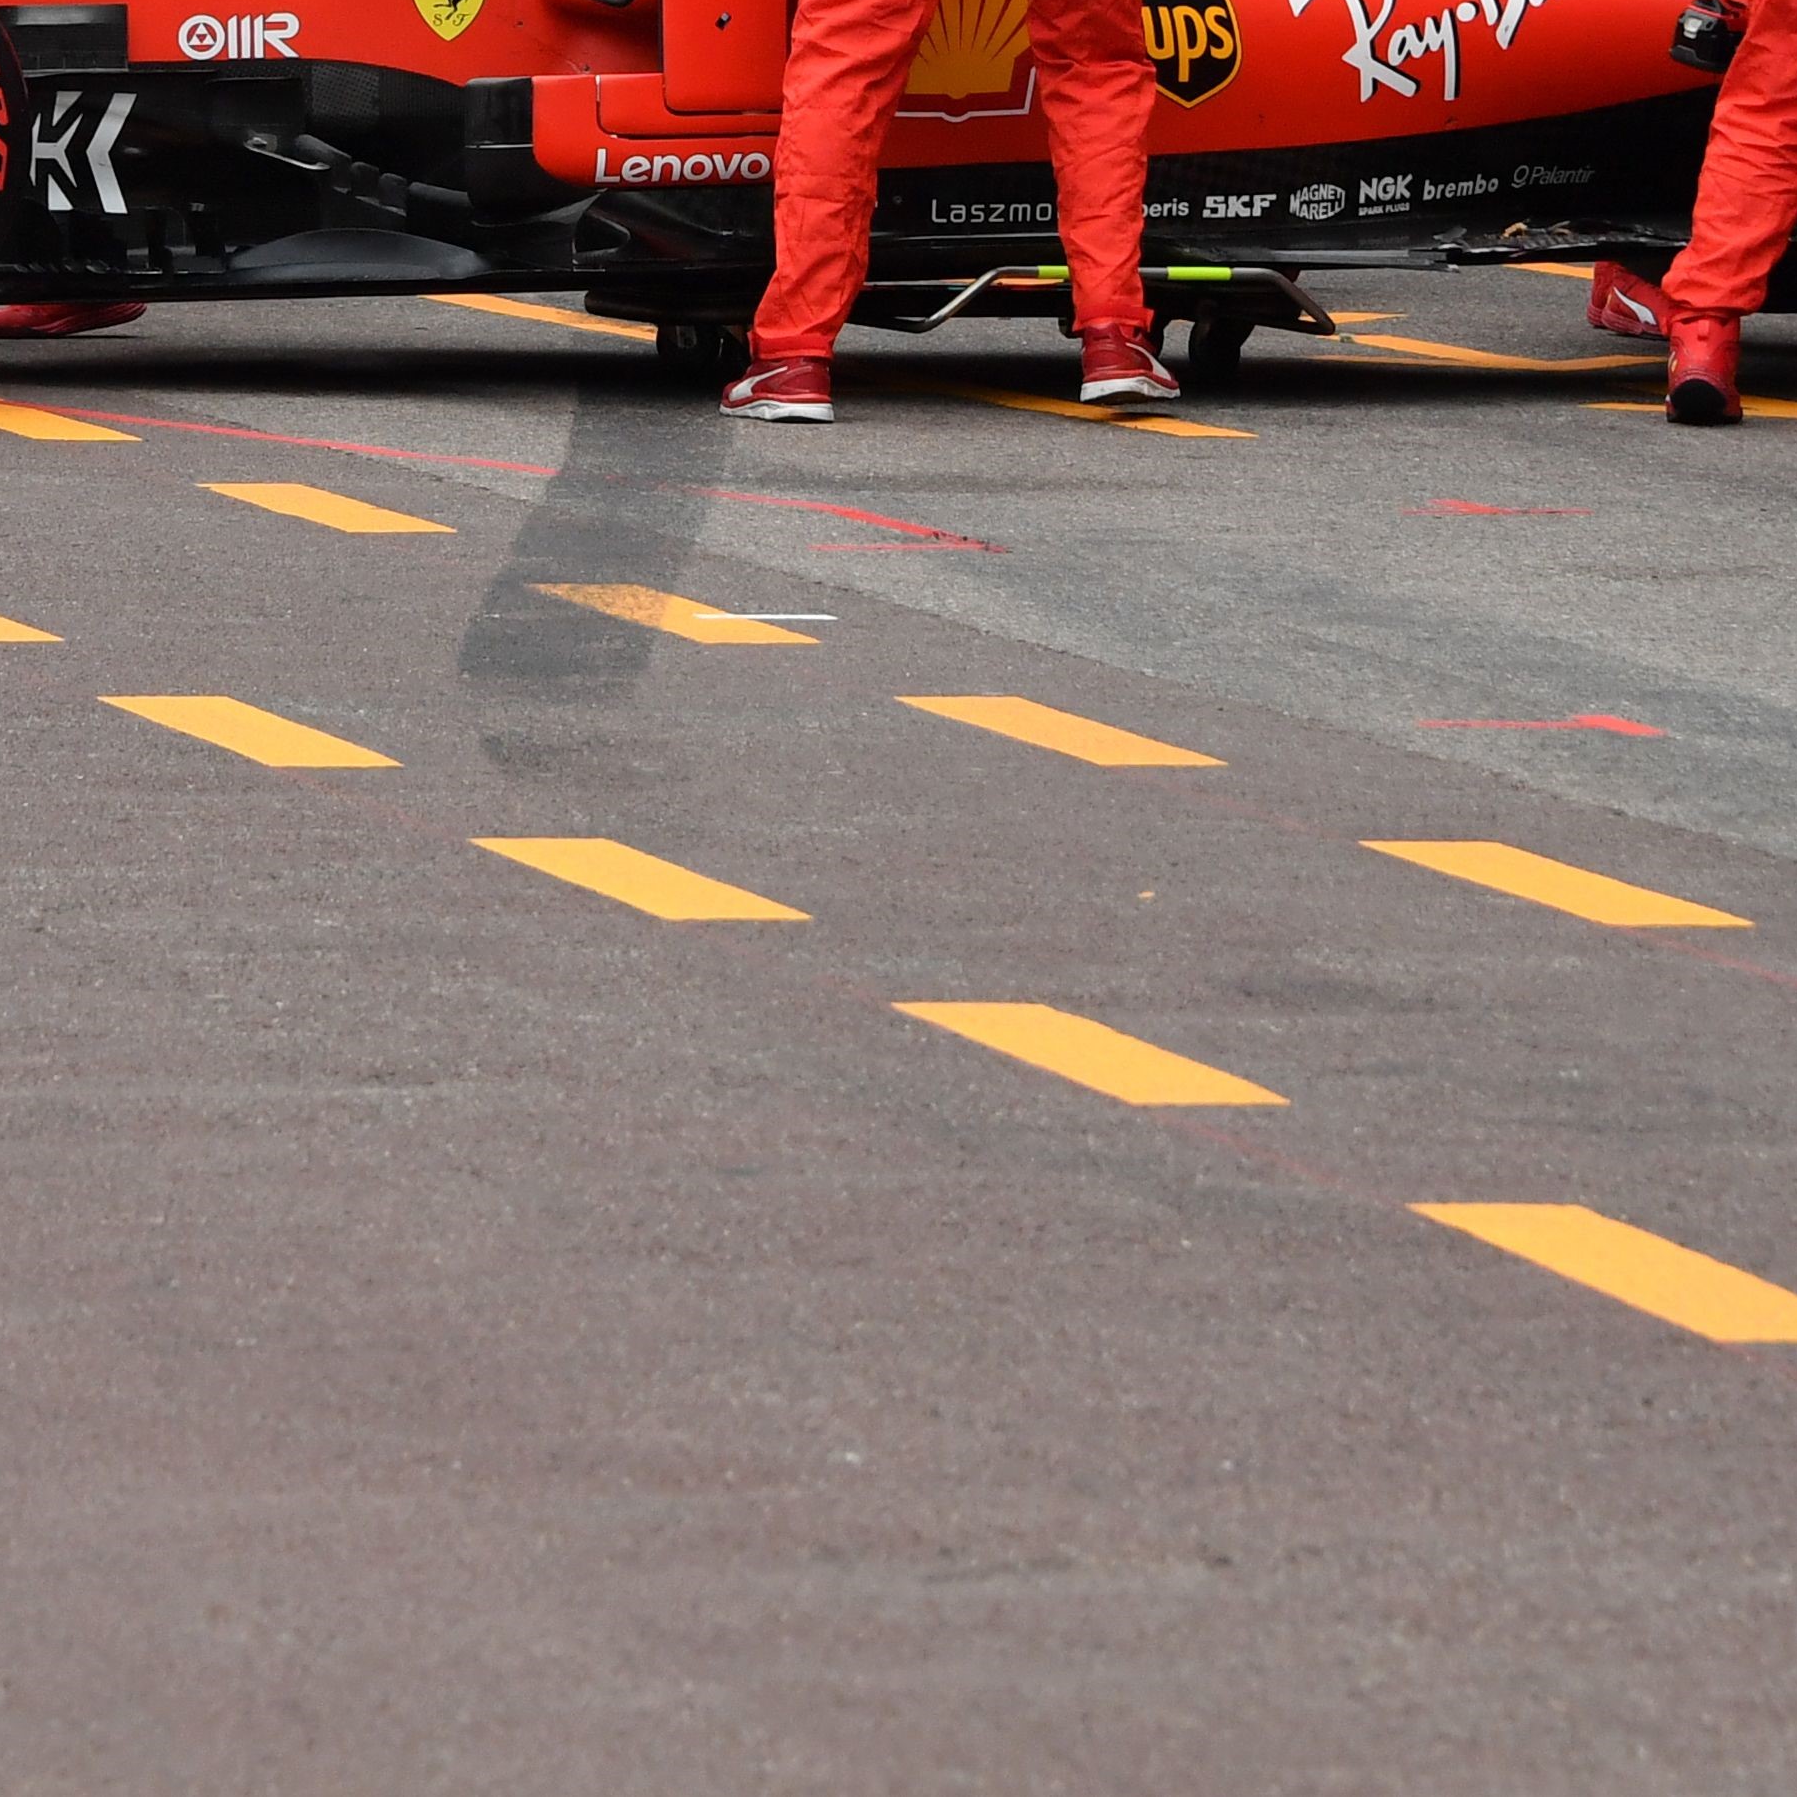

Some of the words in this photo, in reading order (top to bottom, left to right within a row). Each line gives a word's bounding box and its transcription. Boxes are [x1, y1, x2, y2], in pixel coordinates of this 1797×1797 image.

[1142, 4, 1235, 83] ups
[595, 148, 771, 185] Lenovo
[1528, 164, 1596, 186] Palantir
[1358, 174, 1413, 204] NGK
[1422, 174, 1499, 200] brembo
[1203, 193, 1278, 218] SKF
